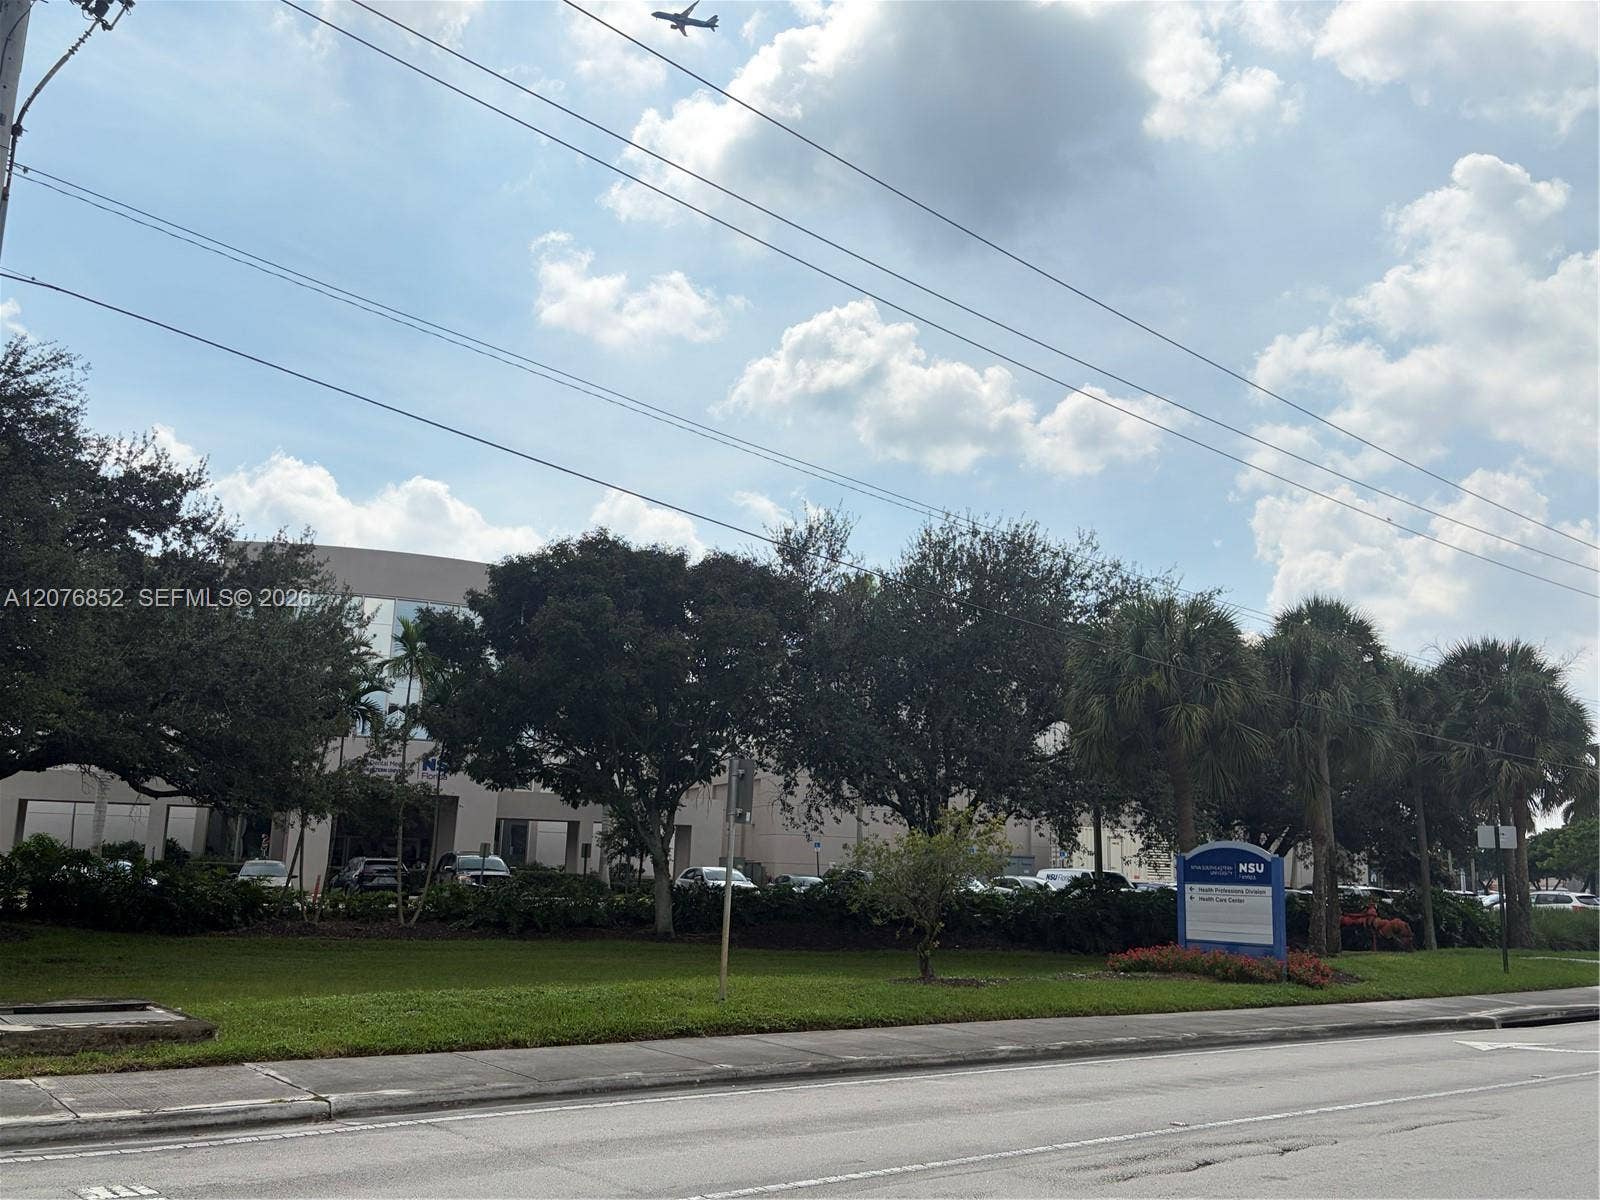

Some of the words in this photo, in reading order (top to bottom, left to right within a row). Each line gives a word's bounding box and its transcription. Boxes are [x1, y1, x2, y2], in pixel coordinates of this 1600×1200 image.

[421, 758, 449, 772] NS
[421, 772, 448, 780] Florda
[1239, 863, 1264, 873] NSU
[1046, 873, 1058, 881] NSU
